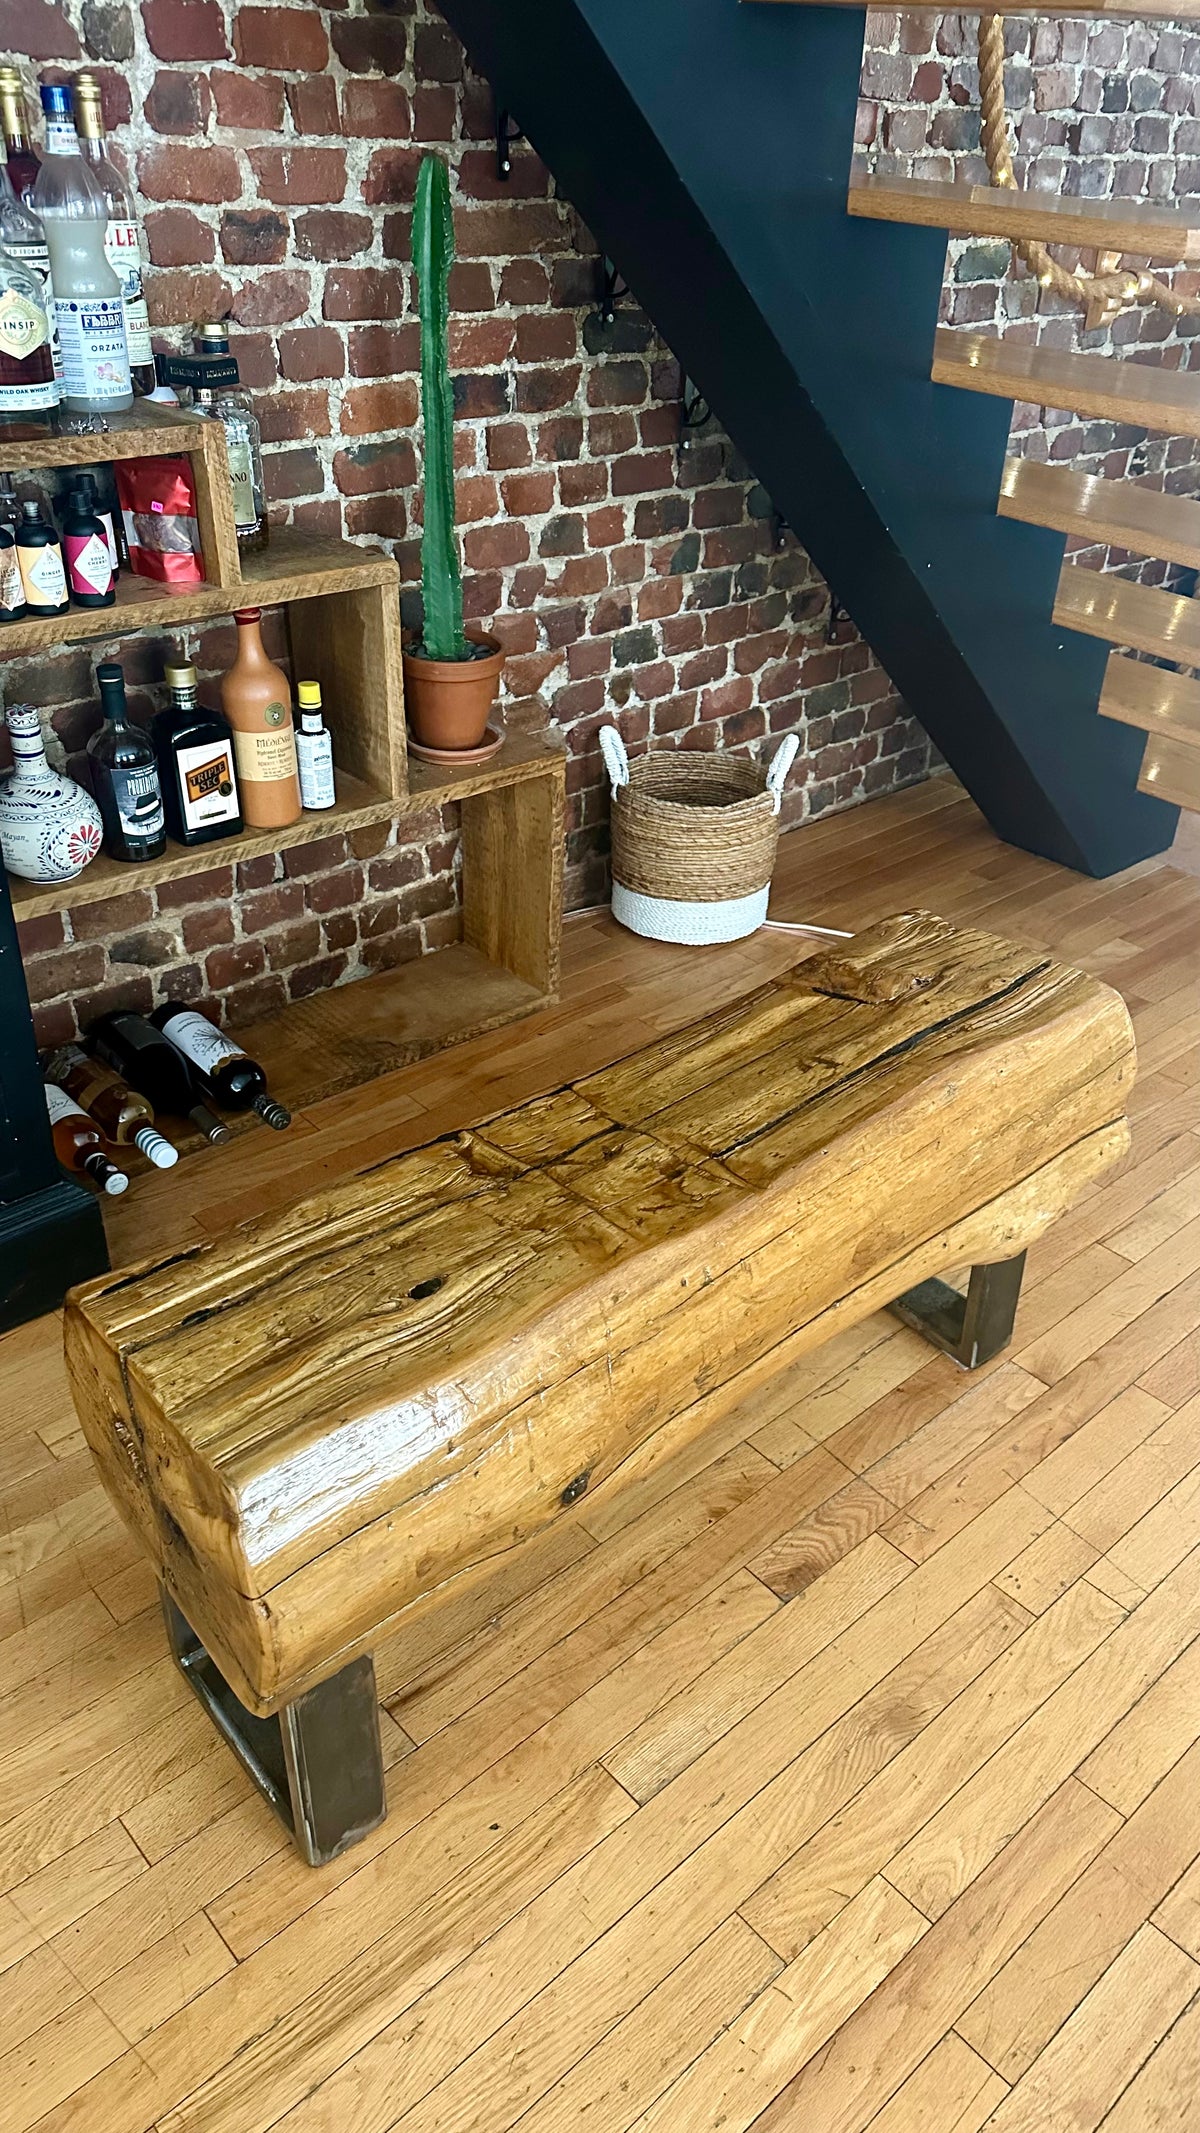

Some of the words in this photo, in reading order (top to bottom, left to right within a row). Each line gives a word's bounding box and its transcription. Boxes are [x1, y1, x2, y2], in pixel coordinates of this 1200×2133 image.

[0, 321, 35, 330] INSIP
[91, 343, 124, 352] ORZATA
[30, 386, 49, 394] WHISKY
[190, 760, 226, 787] TRIPLE
[200, 775, 219, 792] SEC
[2, 831, 26, 842] Mayan
